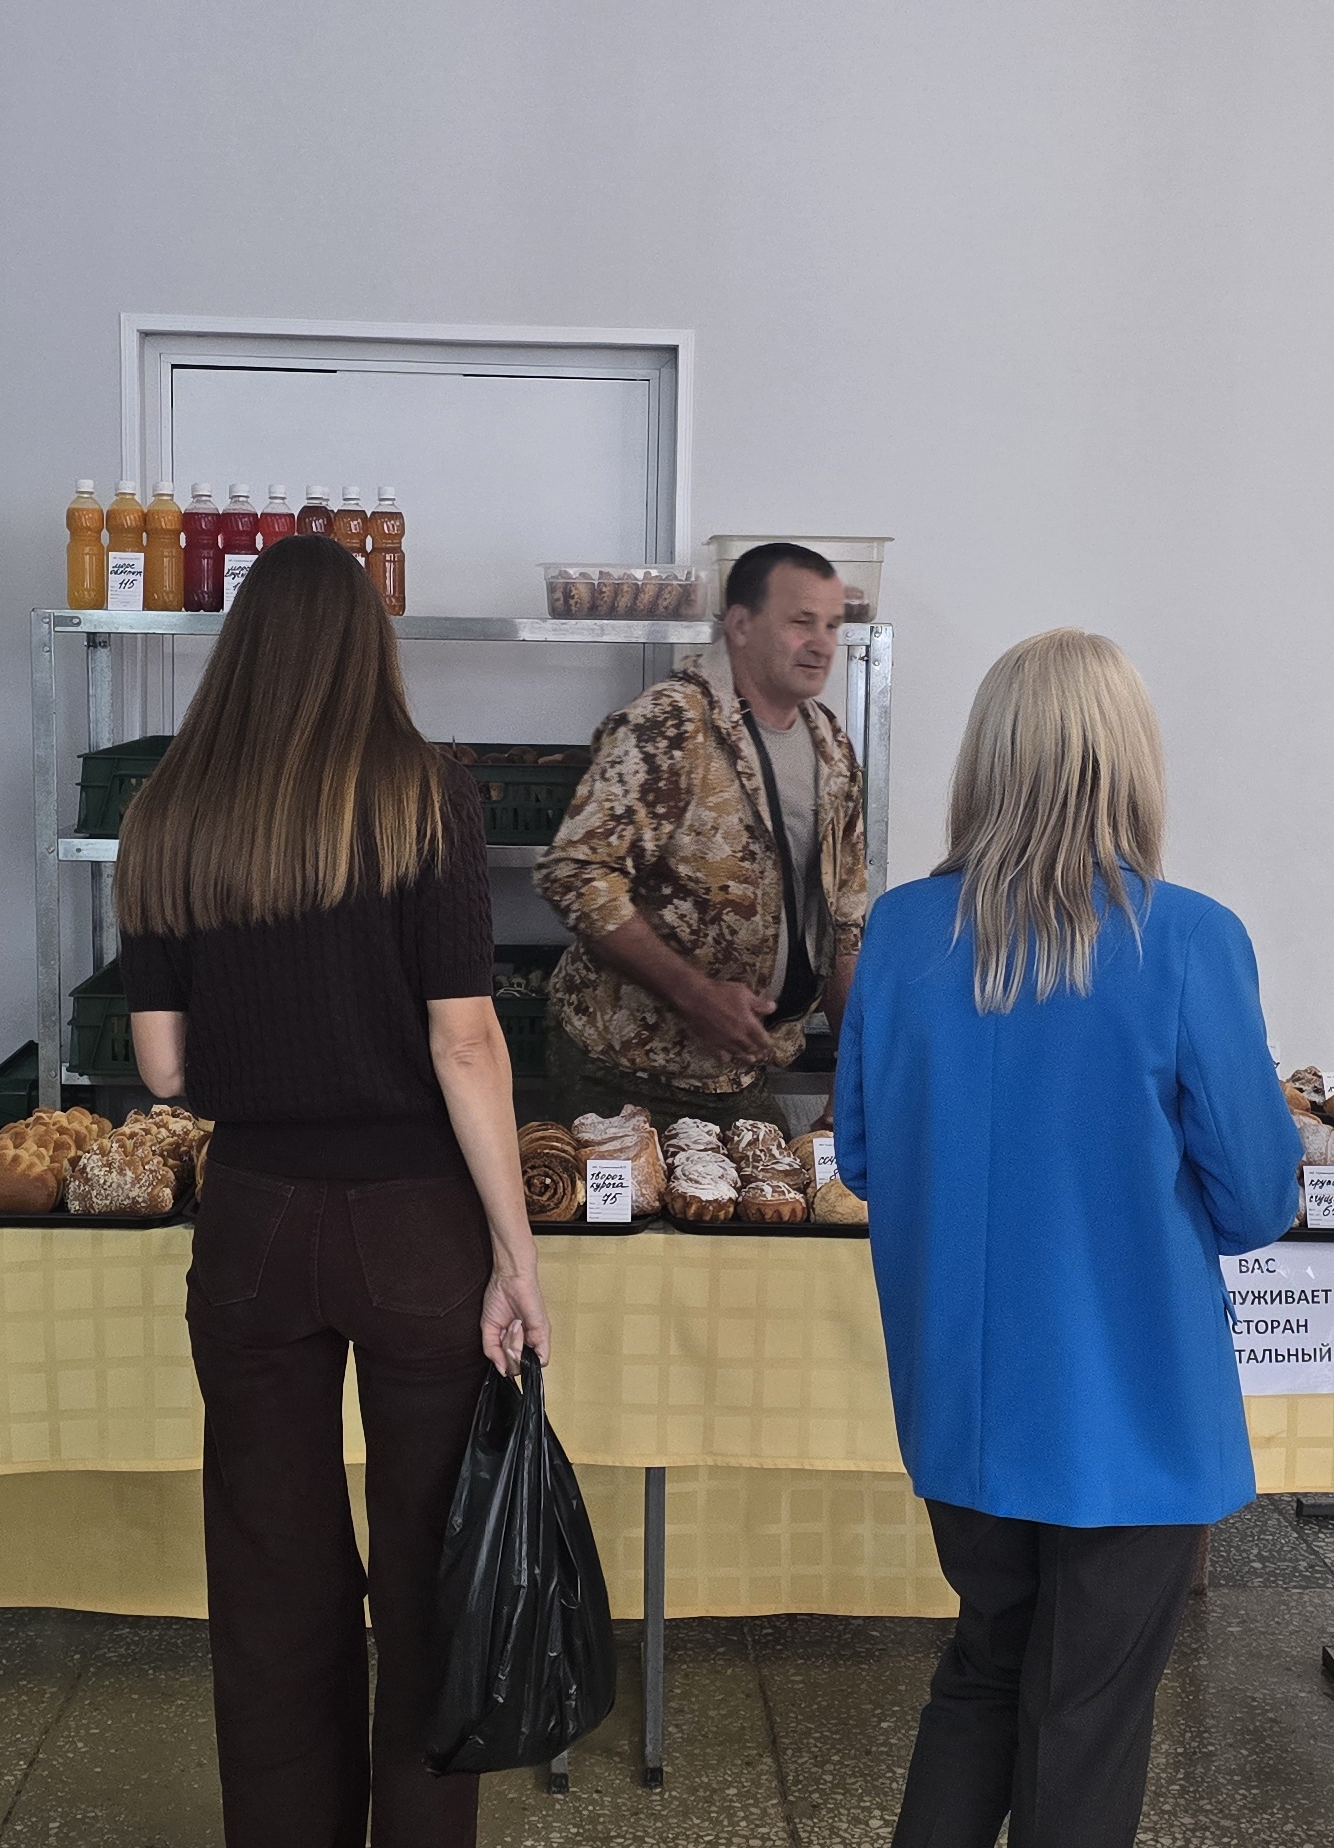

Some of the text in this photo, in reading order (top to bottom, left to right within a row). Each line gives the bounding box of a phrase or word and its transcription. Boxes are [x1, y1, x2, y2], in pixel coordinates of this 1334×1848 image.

[118, 579, 138, 590] 115
[601, 1192, 623, 1205] 75
[1238, 1258, 1277, 1274] ВАС
[1231, 1318, 1309, 1335] СТОРАН
